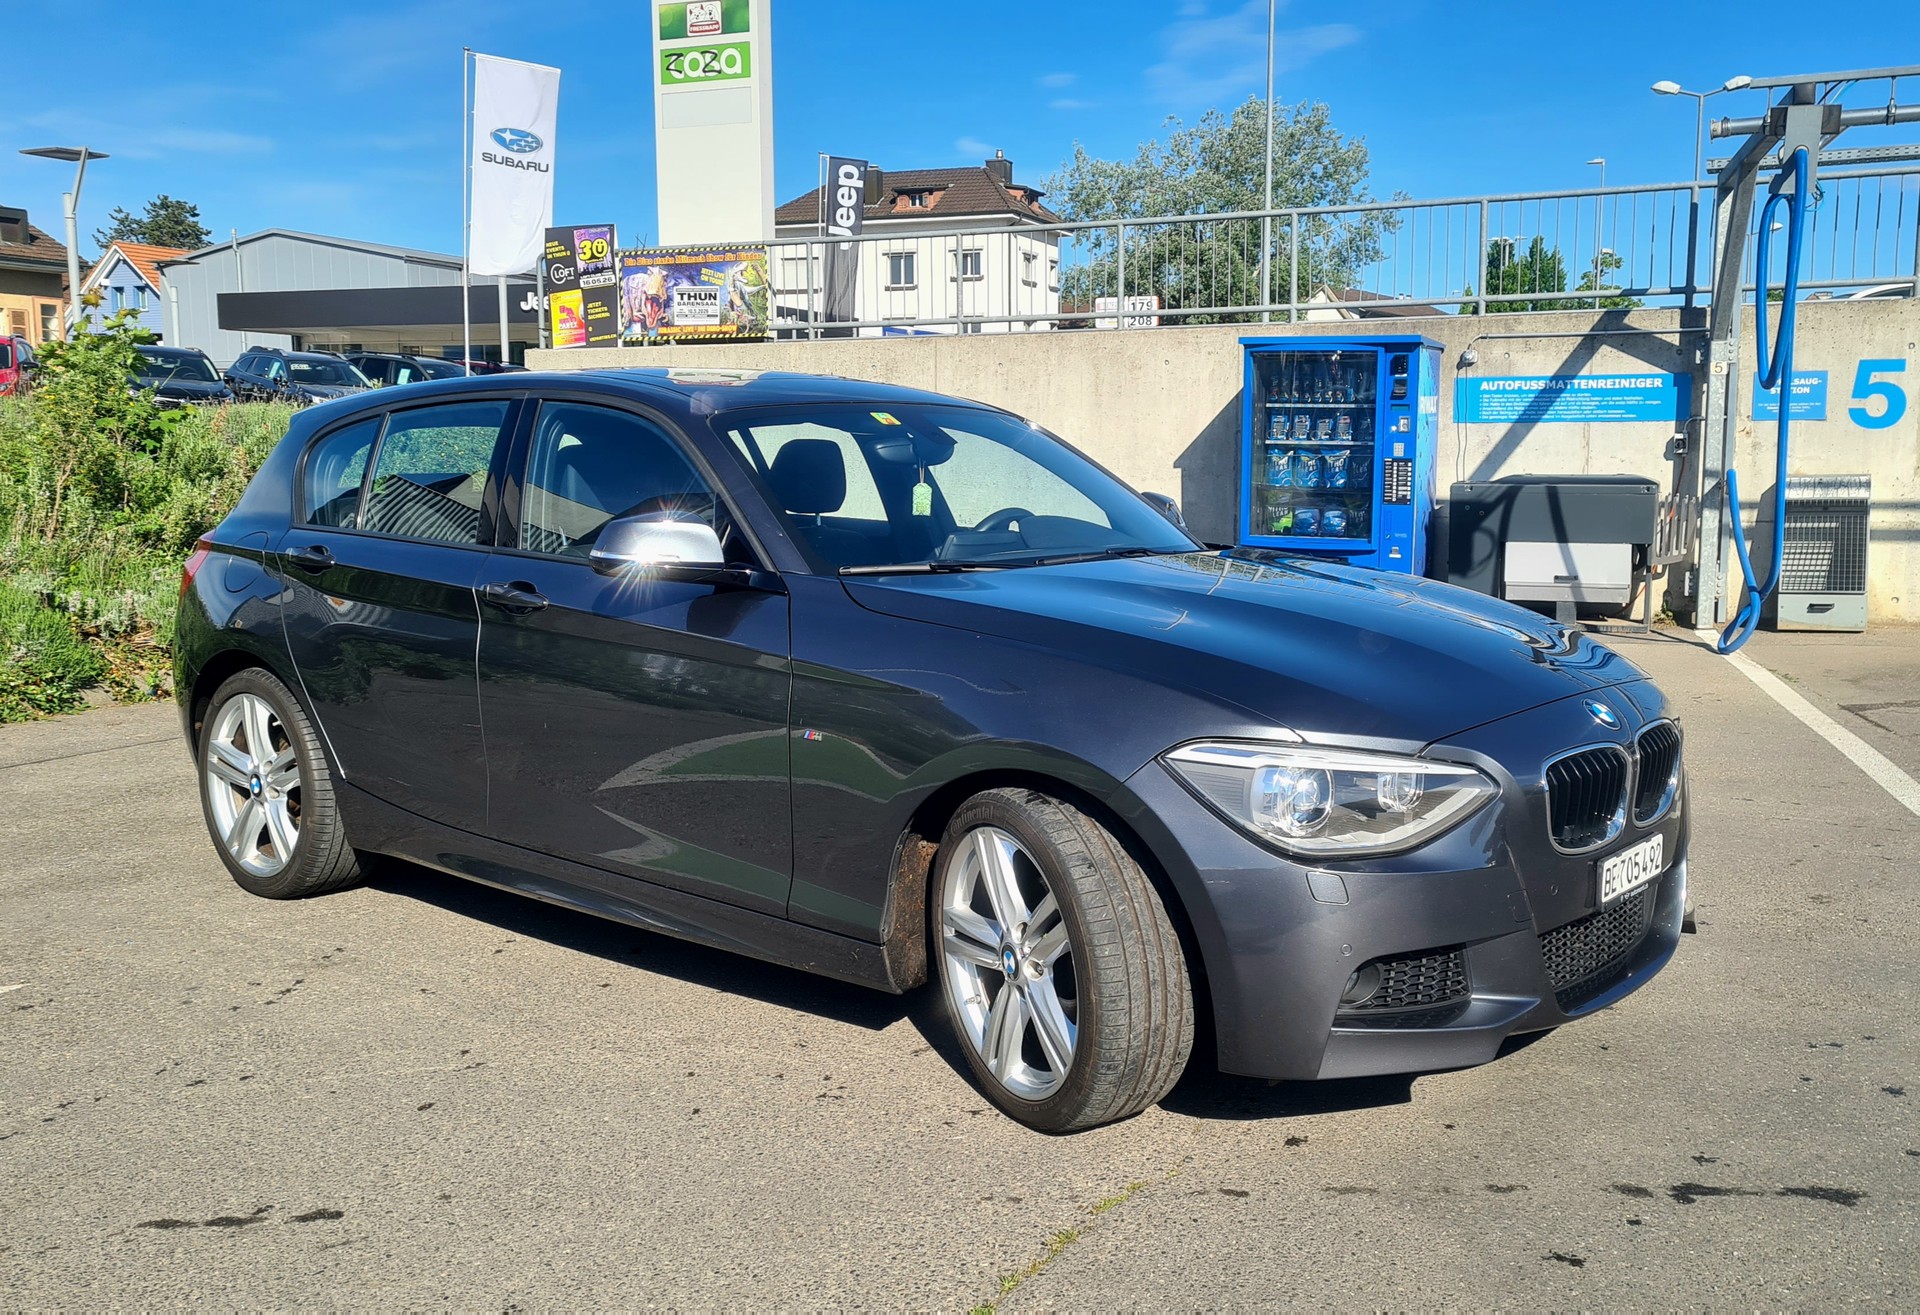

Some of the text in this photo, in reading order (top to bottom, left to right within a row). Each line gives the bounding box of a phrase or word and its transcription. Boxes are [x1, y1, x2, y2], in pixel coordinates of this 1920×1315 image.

[481, 152, 549, 173] SUBARU
[828, 164, 863, 250] Jeep
[624, 257, 636, 266] Die
[637, 256, 653, 265] Dino
[654, 256, 675, 265] starke
[676, 253, 705, 264] Mitmach
[706, 253, 724, 263] Show
[553, 267, 575, 279] LOFT
[677, 292, 718, 301] THUN
[1130, 301, 1153, 311] 179
[1130, 315, 1152, 326] 208
[1714, 361, 1723, 374] 5
[1480, 378, 1663, 391] AUTOFUSSMATTENREINIGER
[1847, 358, 1908, 430] 5
